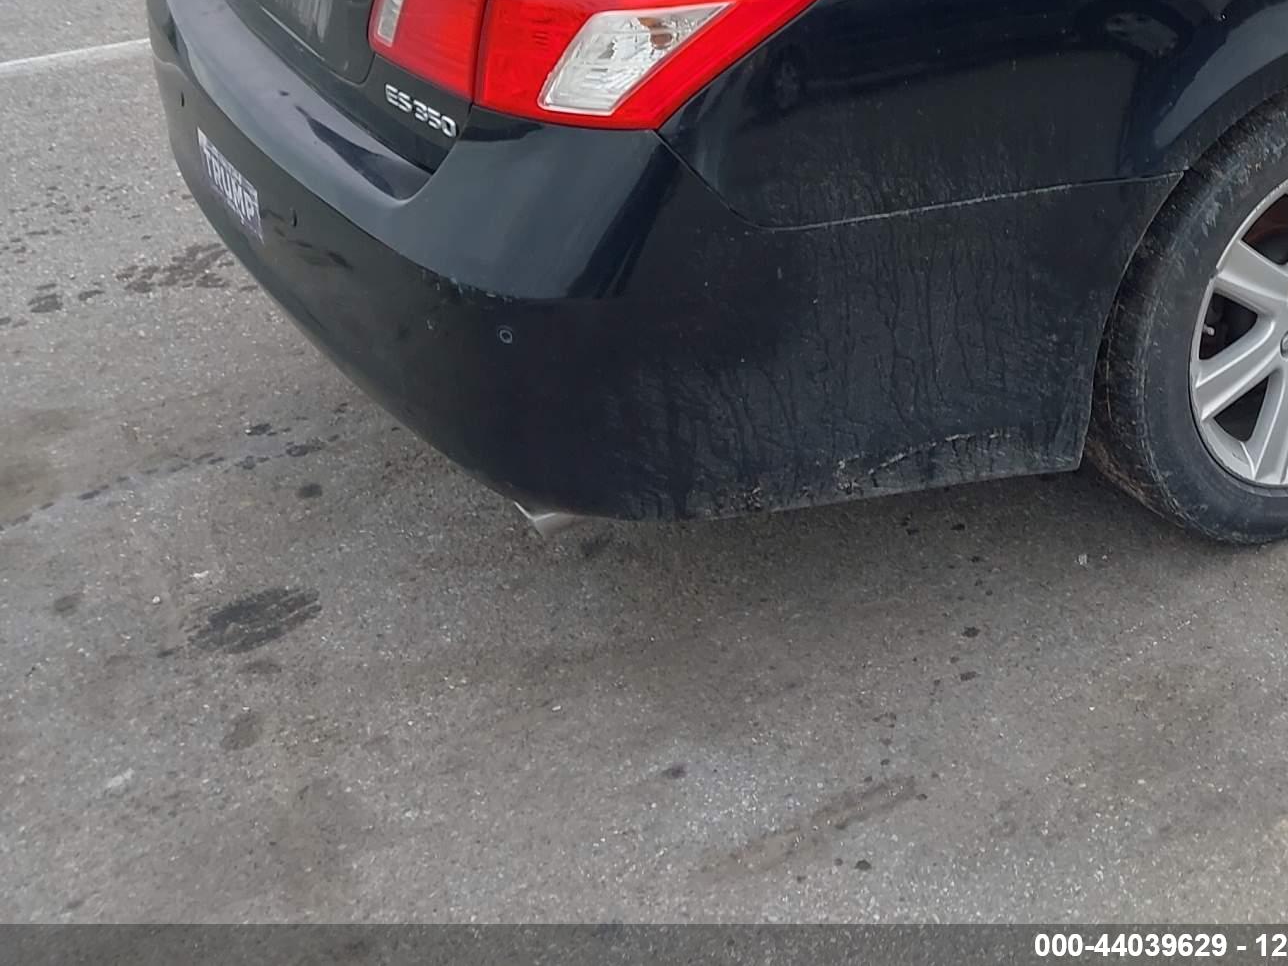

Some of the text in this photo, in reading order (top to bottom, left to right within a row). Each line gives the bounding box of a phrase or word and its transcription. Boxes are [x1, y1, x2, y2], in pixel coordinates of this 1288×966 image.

[385, 83, 457, 138] ES 350
[203, 145, 256, 221] TRUMP
